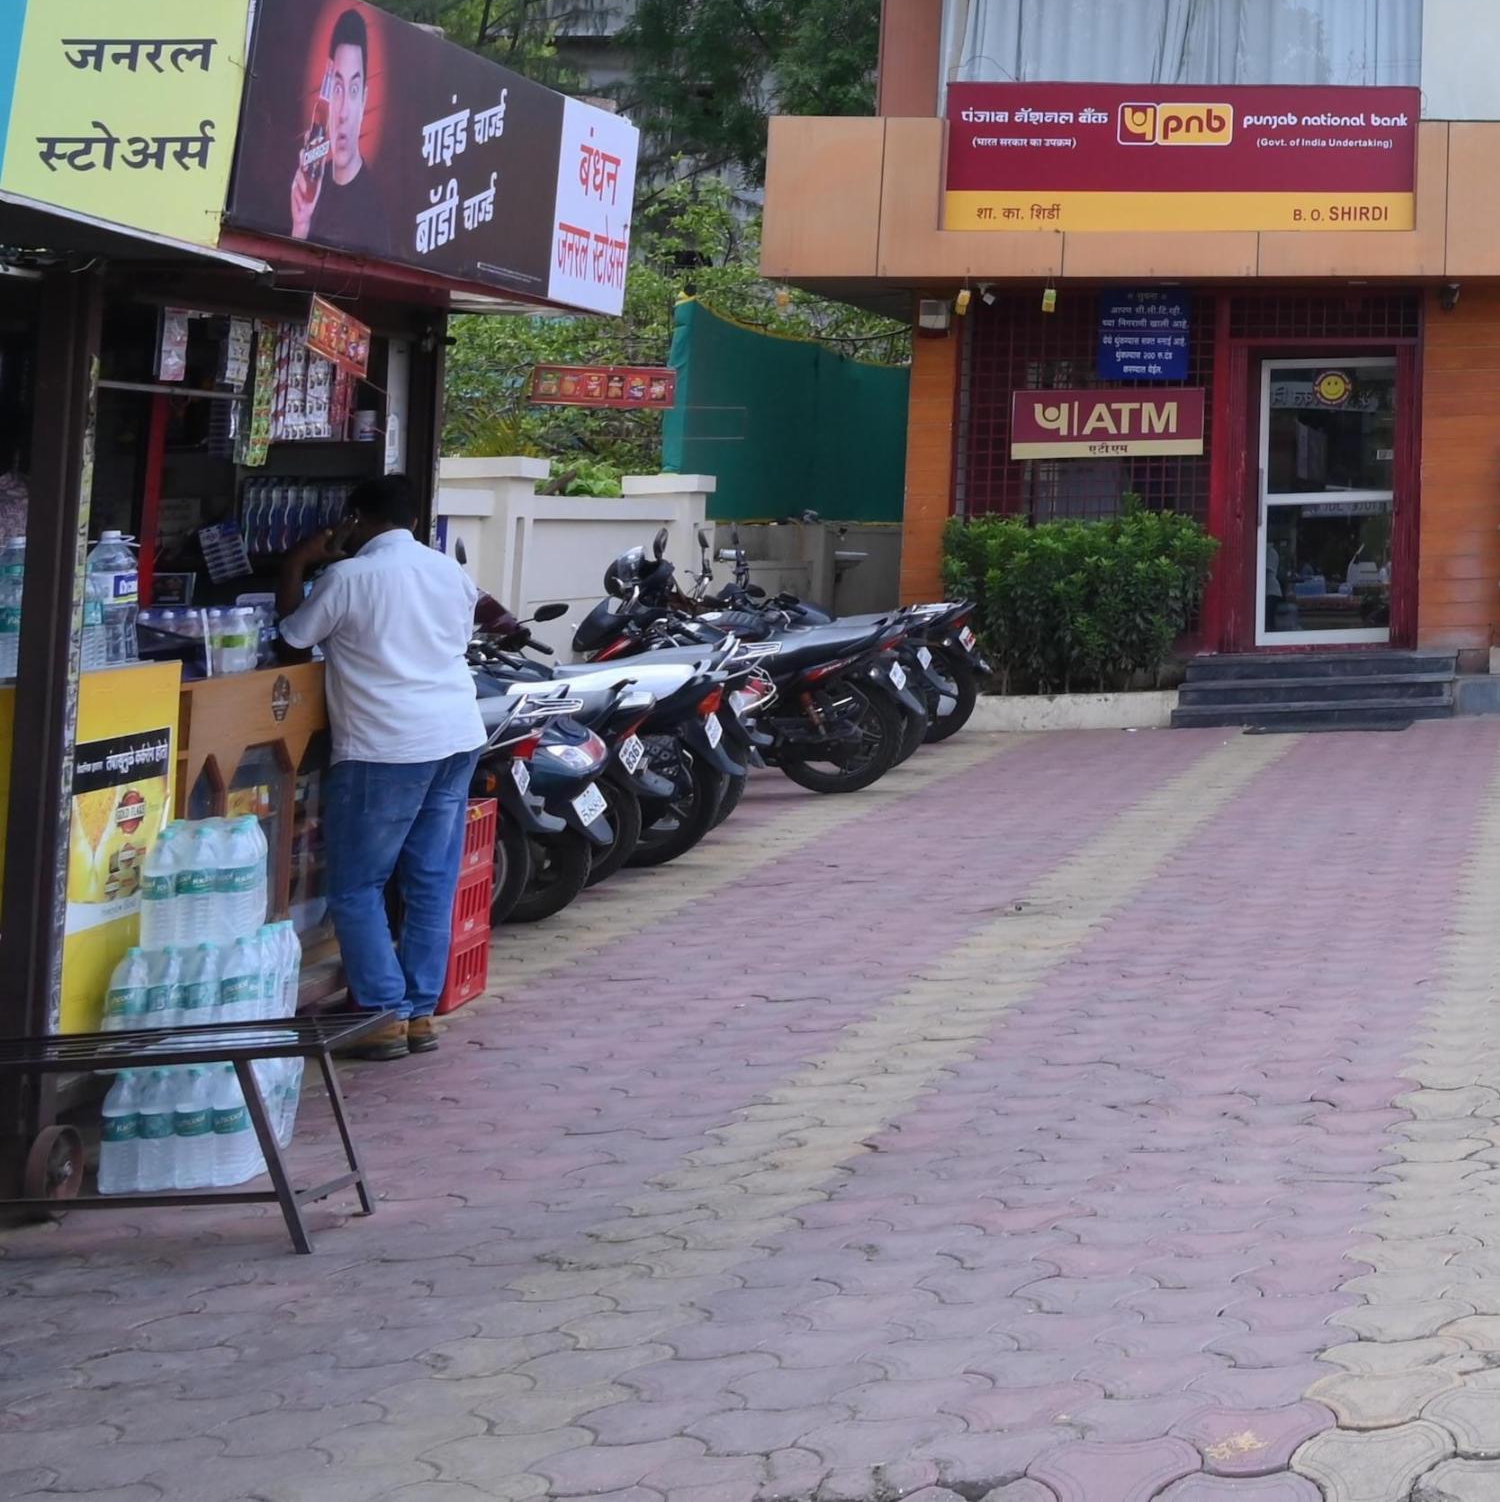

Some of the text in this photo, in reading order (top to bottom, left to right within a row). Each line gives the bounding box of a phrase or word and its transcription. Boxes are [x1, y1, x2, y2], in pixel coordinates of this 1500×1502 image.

[61, 37, 218, 74] जनरल
[422, 94, 470, 167] माइंड
[961, 106, 1009, 123] पंजाब
[1163, 108, 1226, 140] pnb
[1243, 113, 1408, 129] punjab national bank
[35, 119, 216, 173] स्टोअर्स
[999, 138, 1028, 147] सरकार
[1030, 138, 1042, 147] का
[1256, 138, 1393, 148] (Govt. of India Undertaking)
[580, 127, 621, 206] बंधन
[416, 178, 459, 254] बॉडी
[1030, 204, 1061, 220] शिर्डी
[1294, 206, 1388, 221] B. O. SHIRDI
[558, 222, 590, 281] जनरल
[1082, 402, 1178, 434] ATM
